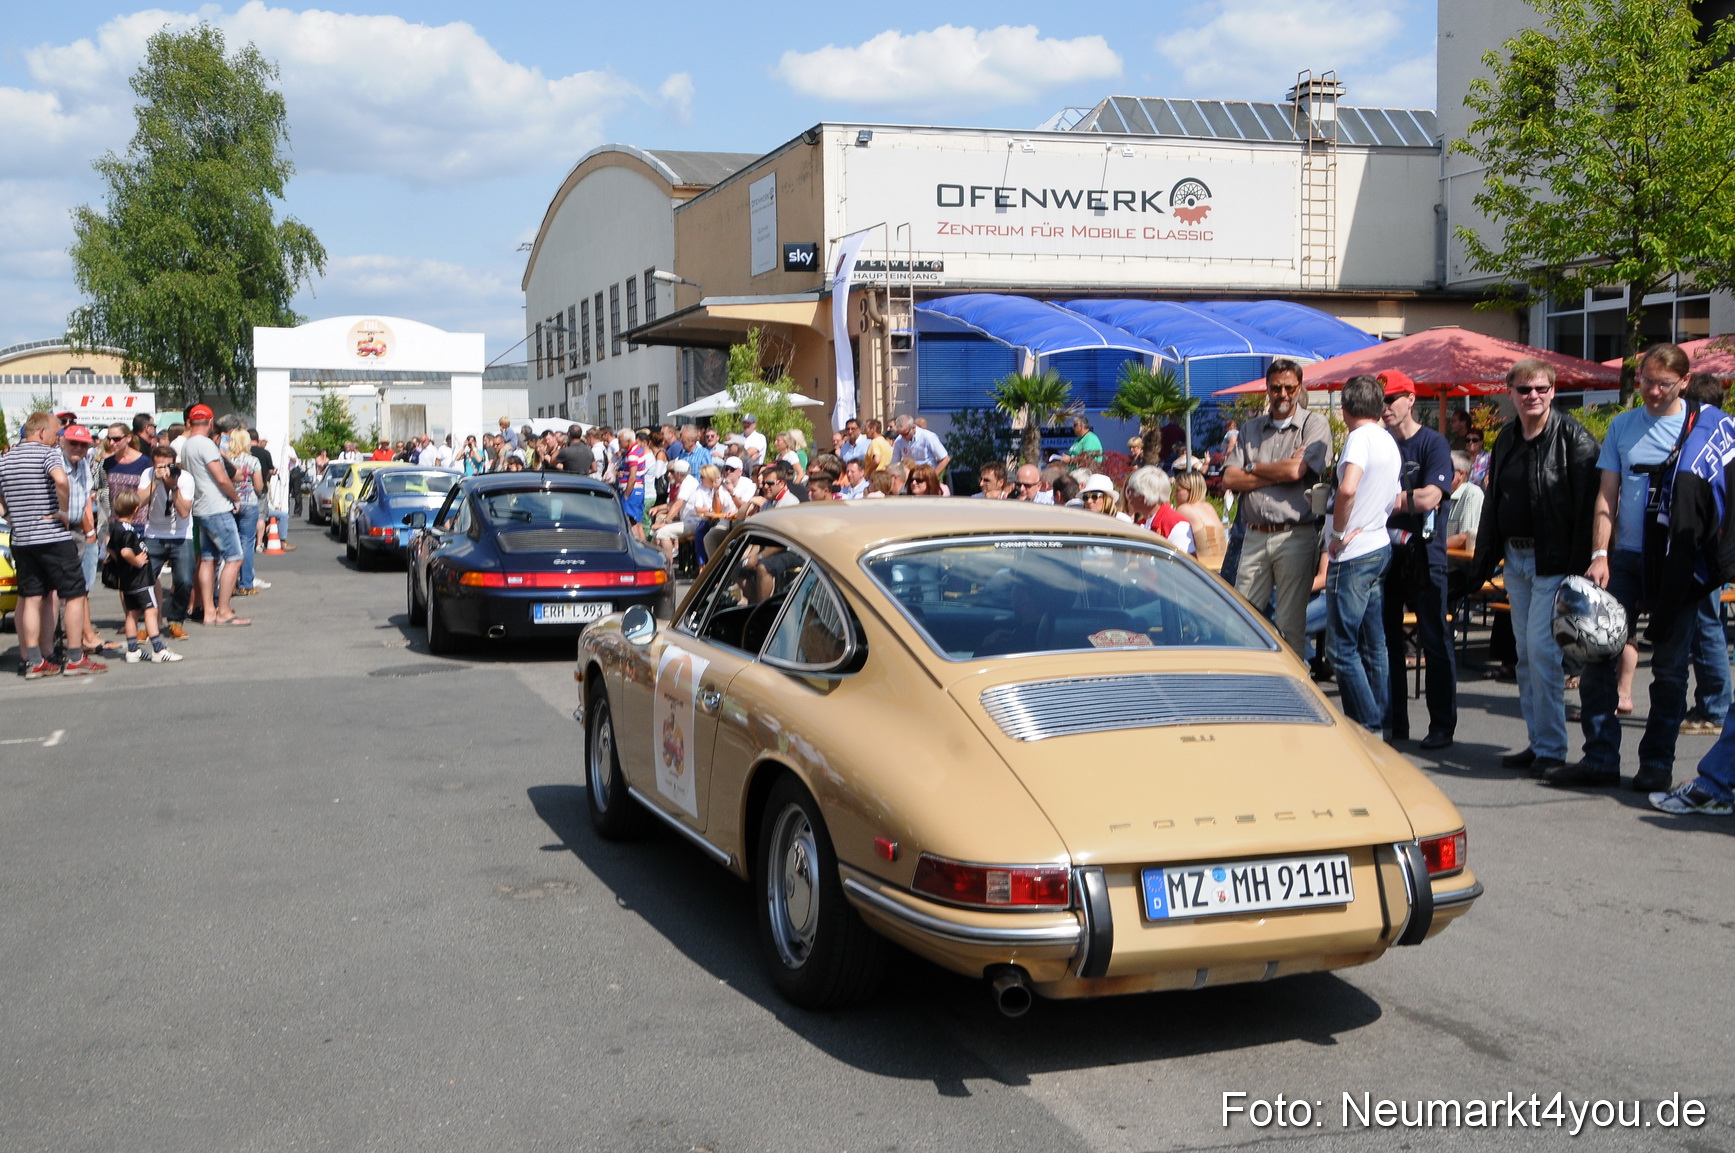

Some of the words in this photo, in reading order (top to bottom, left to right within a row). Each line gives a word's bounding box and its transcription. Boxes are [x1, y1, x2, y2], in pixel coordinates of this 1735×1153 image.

[937, 183, 1166, 214] OFENWERK
[937, 221, 1024, 236] ZENTRUM
[1031, 222, 1064, 237] FÜR
[1071, 225, 1137, 239] MOBILE
[1143, 226, 1214, 241] CLASSIC
[788, 248, 814, 265] sky
[853, 272, 938, 280] HAUPTEINGANG
[80, 395, 138, 408] FAT
[543, 604, 565, 617] ERH
[583, 604, 603, 617] 993
[1109, 807, 1370, 833] PORSCHE
[1167, 871, 1209, 909] MZ
[1231, 865, 1271, 903] MH
[1277, 860, 1350, 900] 911H
